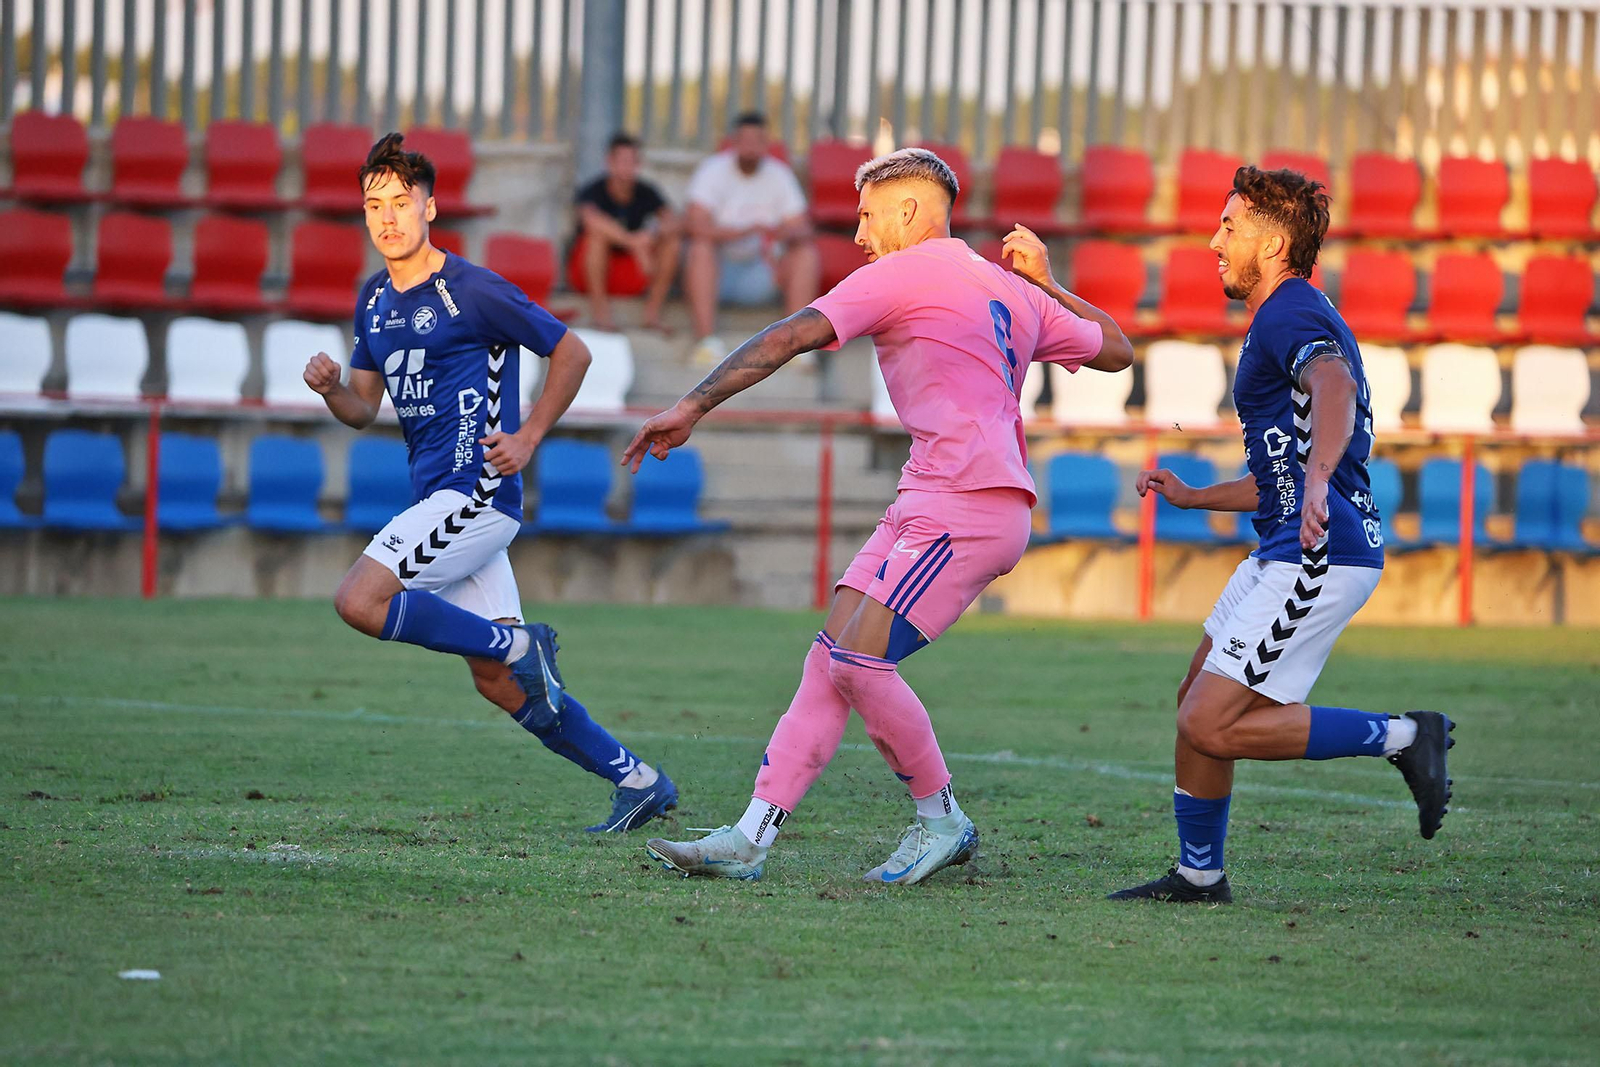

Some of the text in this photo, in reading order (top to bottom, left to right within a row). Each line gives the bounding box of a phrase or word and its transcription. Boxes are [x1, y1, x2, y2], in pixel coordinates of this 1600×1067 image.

[401, 374, 434, 400] Air
[468, 413, 477, 428] LA
[1280, 457, 1289, 473] LA
[1285, 473, 1296, 515] TIENDA
